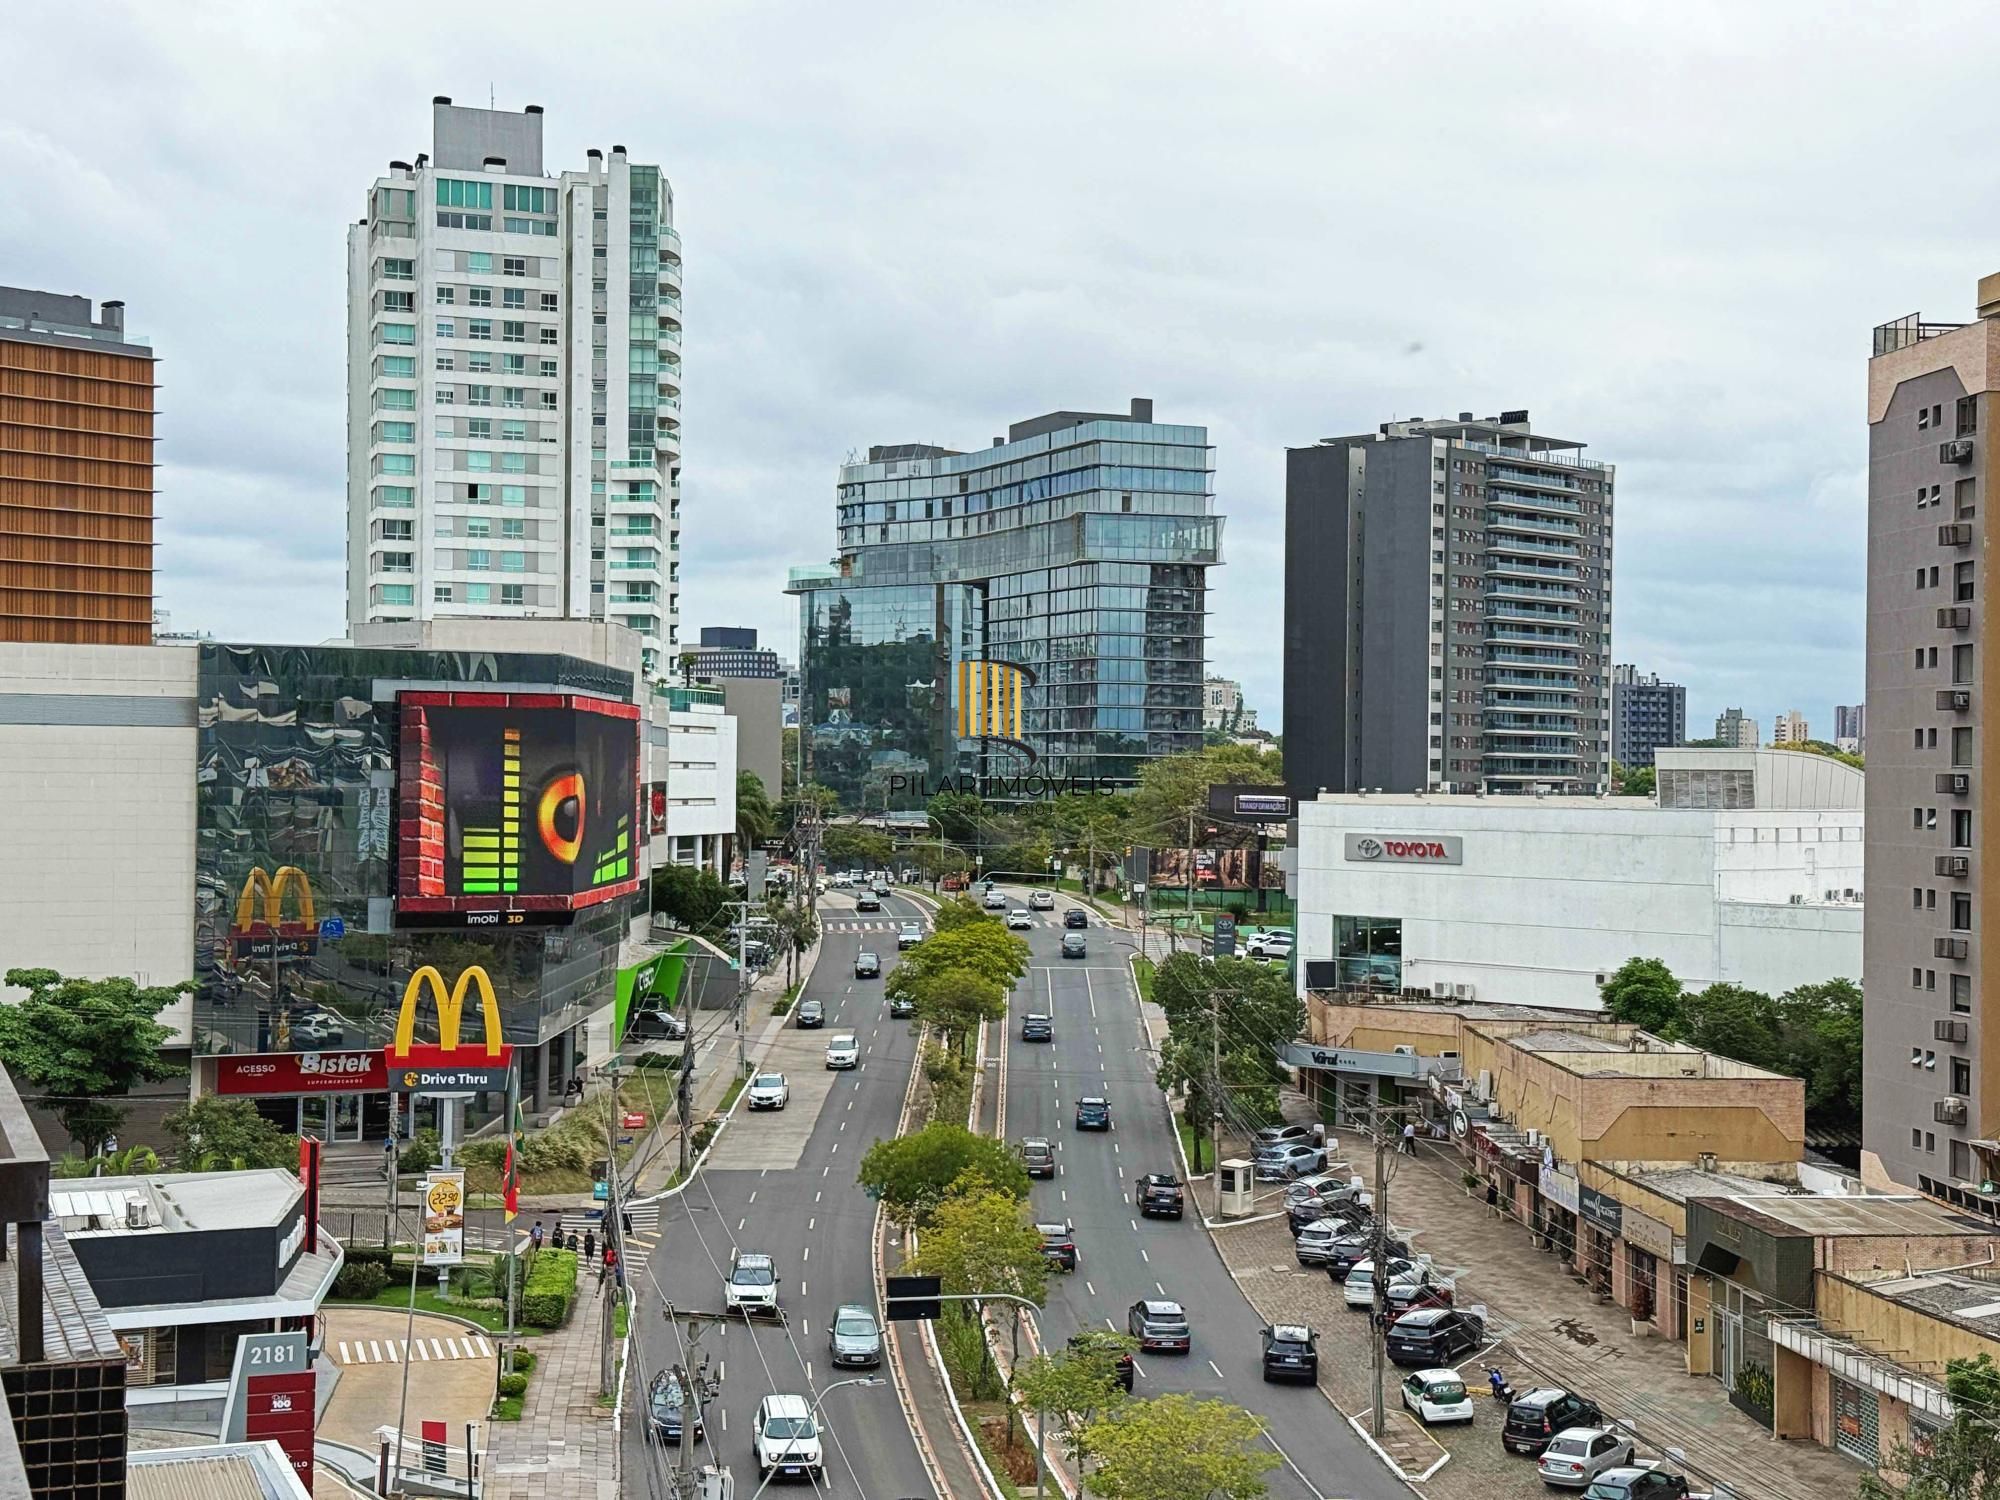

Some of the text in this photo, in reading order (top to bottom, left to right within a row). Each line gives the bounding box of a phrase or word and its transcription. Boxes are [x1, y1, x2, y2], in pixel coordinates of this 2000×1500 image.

[1384, 841, 1448, 858] TOYOTA
[467, 913, 524, 924] imobi 3D
[235, 1064, 277, 1074] ACESSO
[421, 1073, 488, 1085] Drive Thru
[250, 1344, 295, 1365] 2181
[1433, 1385, 1450, 1394] STV
[272, 1399, 292, 1409] 100
